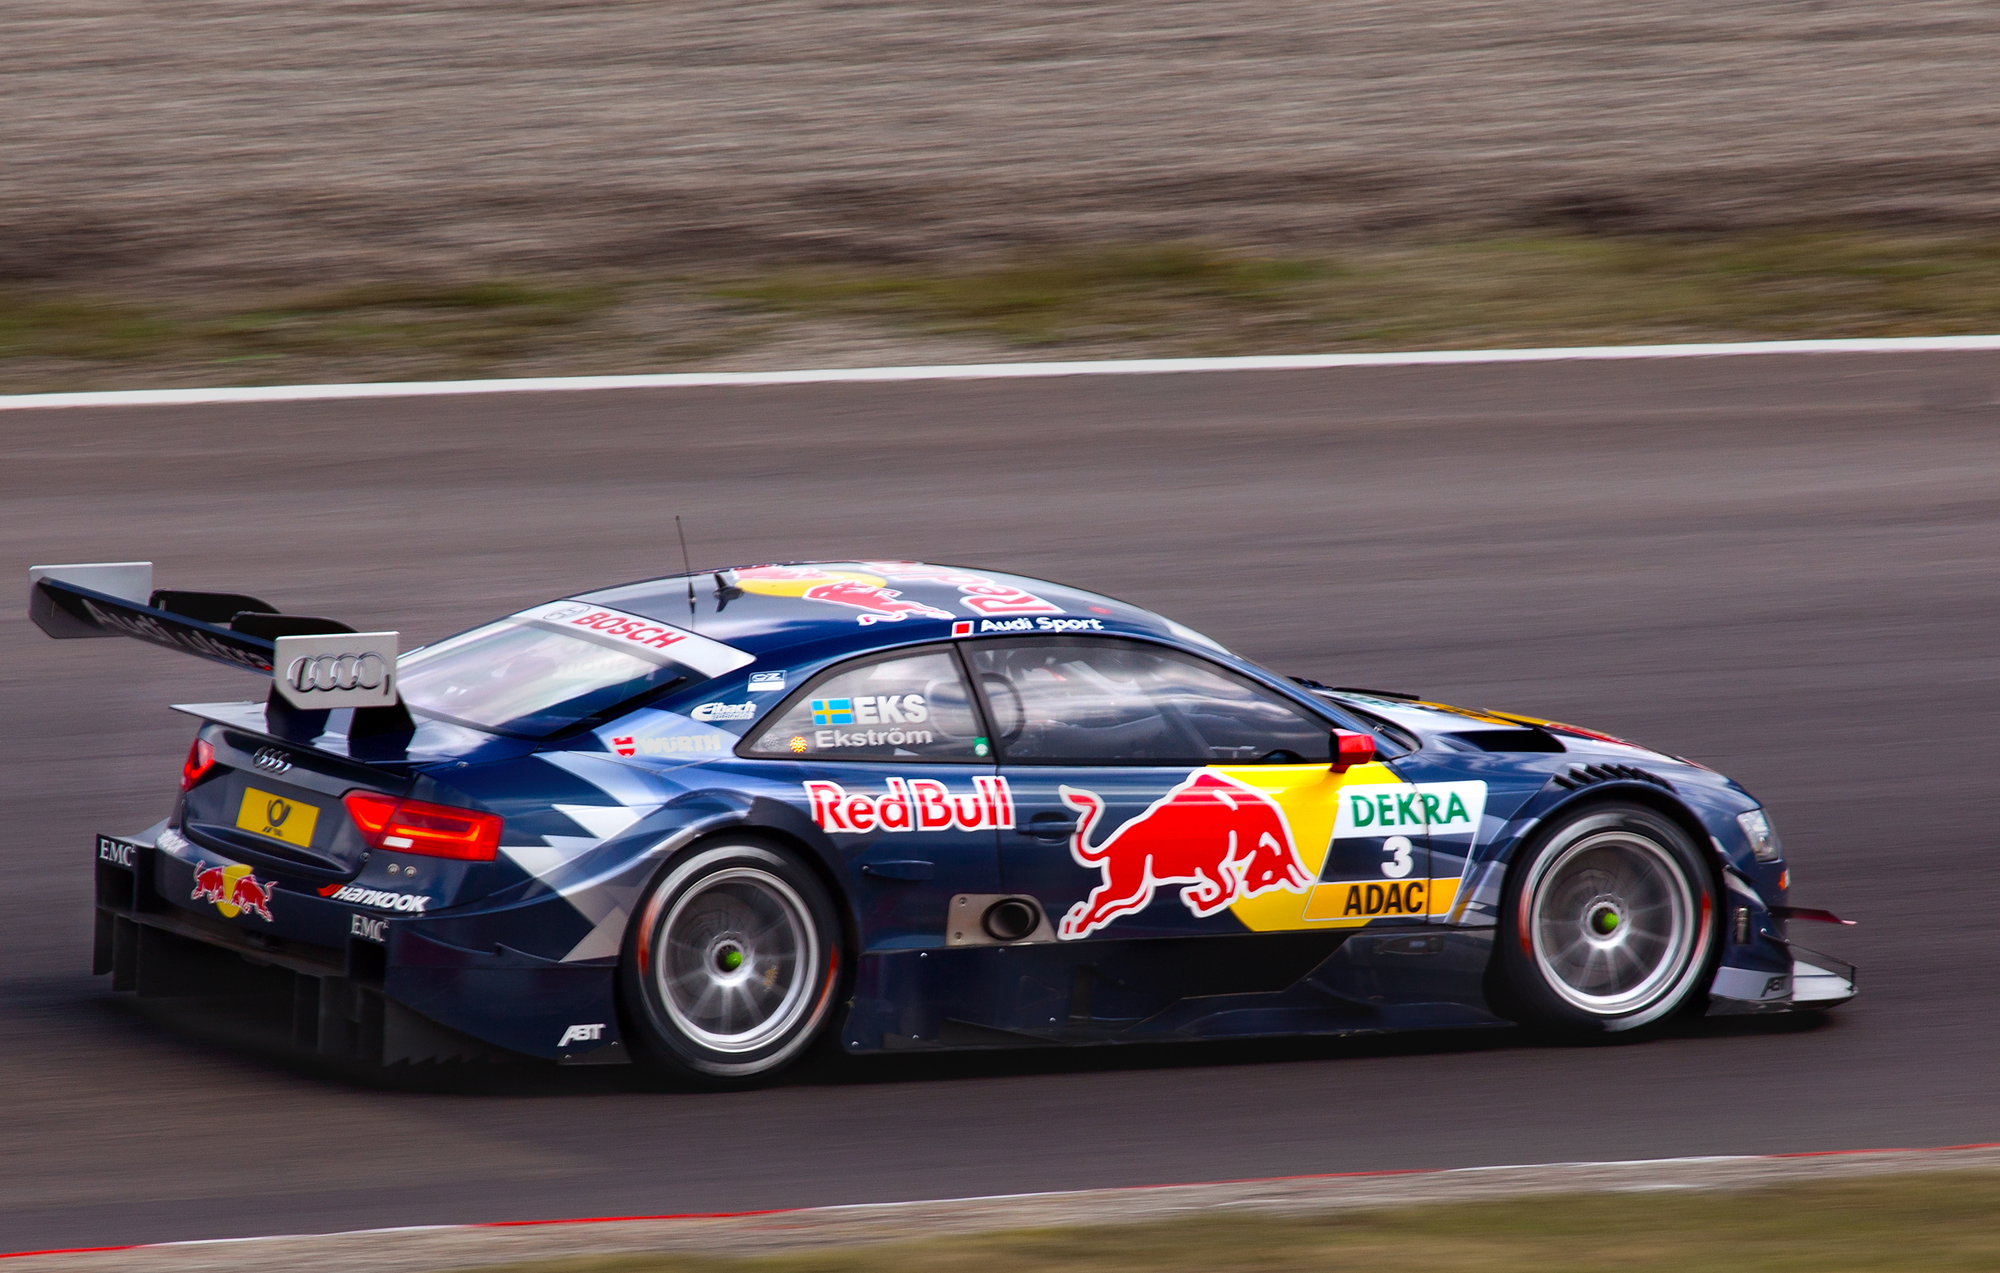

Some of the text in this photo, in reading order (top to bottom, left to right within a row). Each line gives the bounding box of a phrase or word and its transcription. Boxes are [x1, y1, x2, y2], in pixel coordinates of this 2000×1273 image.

[571, 611, 688, 649] BOSCH
[980, 616, 1105, 633] Audi Sport
[691, 701, 757, 721] Eibach
[853, 693, 929, 725] EKS
[815, 727, 934, 748] Ekström
[1350, 791, 1471, 828] DEKRA
[1380, 835, 1415, 879] 3
[1343, 881, 1424, 916] ADAC
[557, 1023, 607, 1047] ABT
